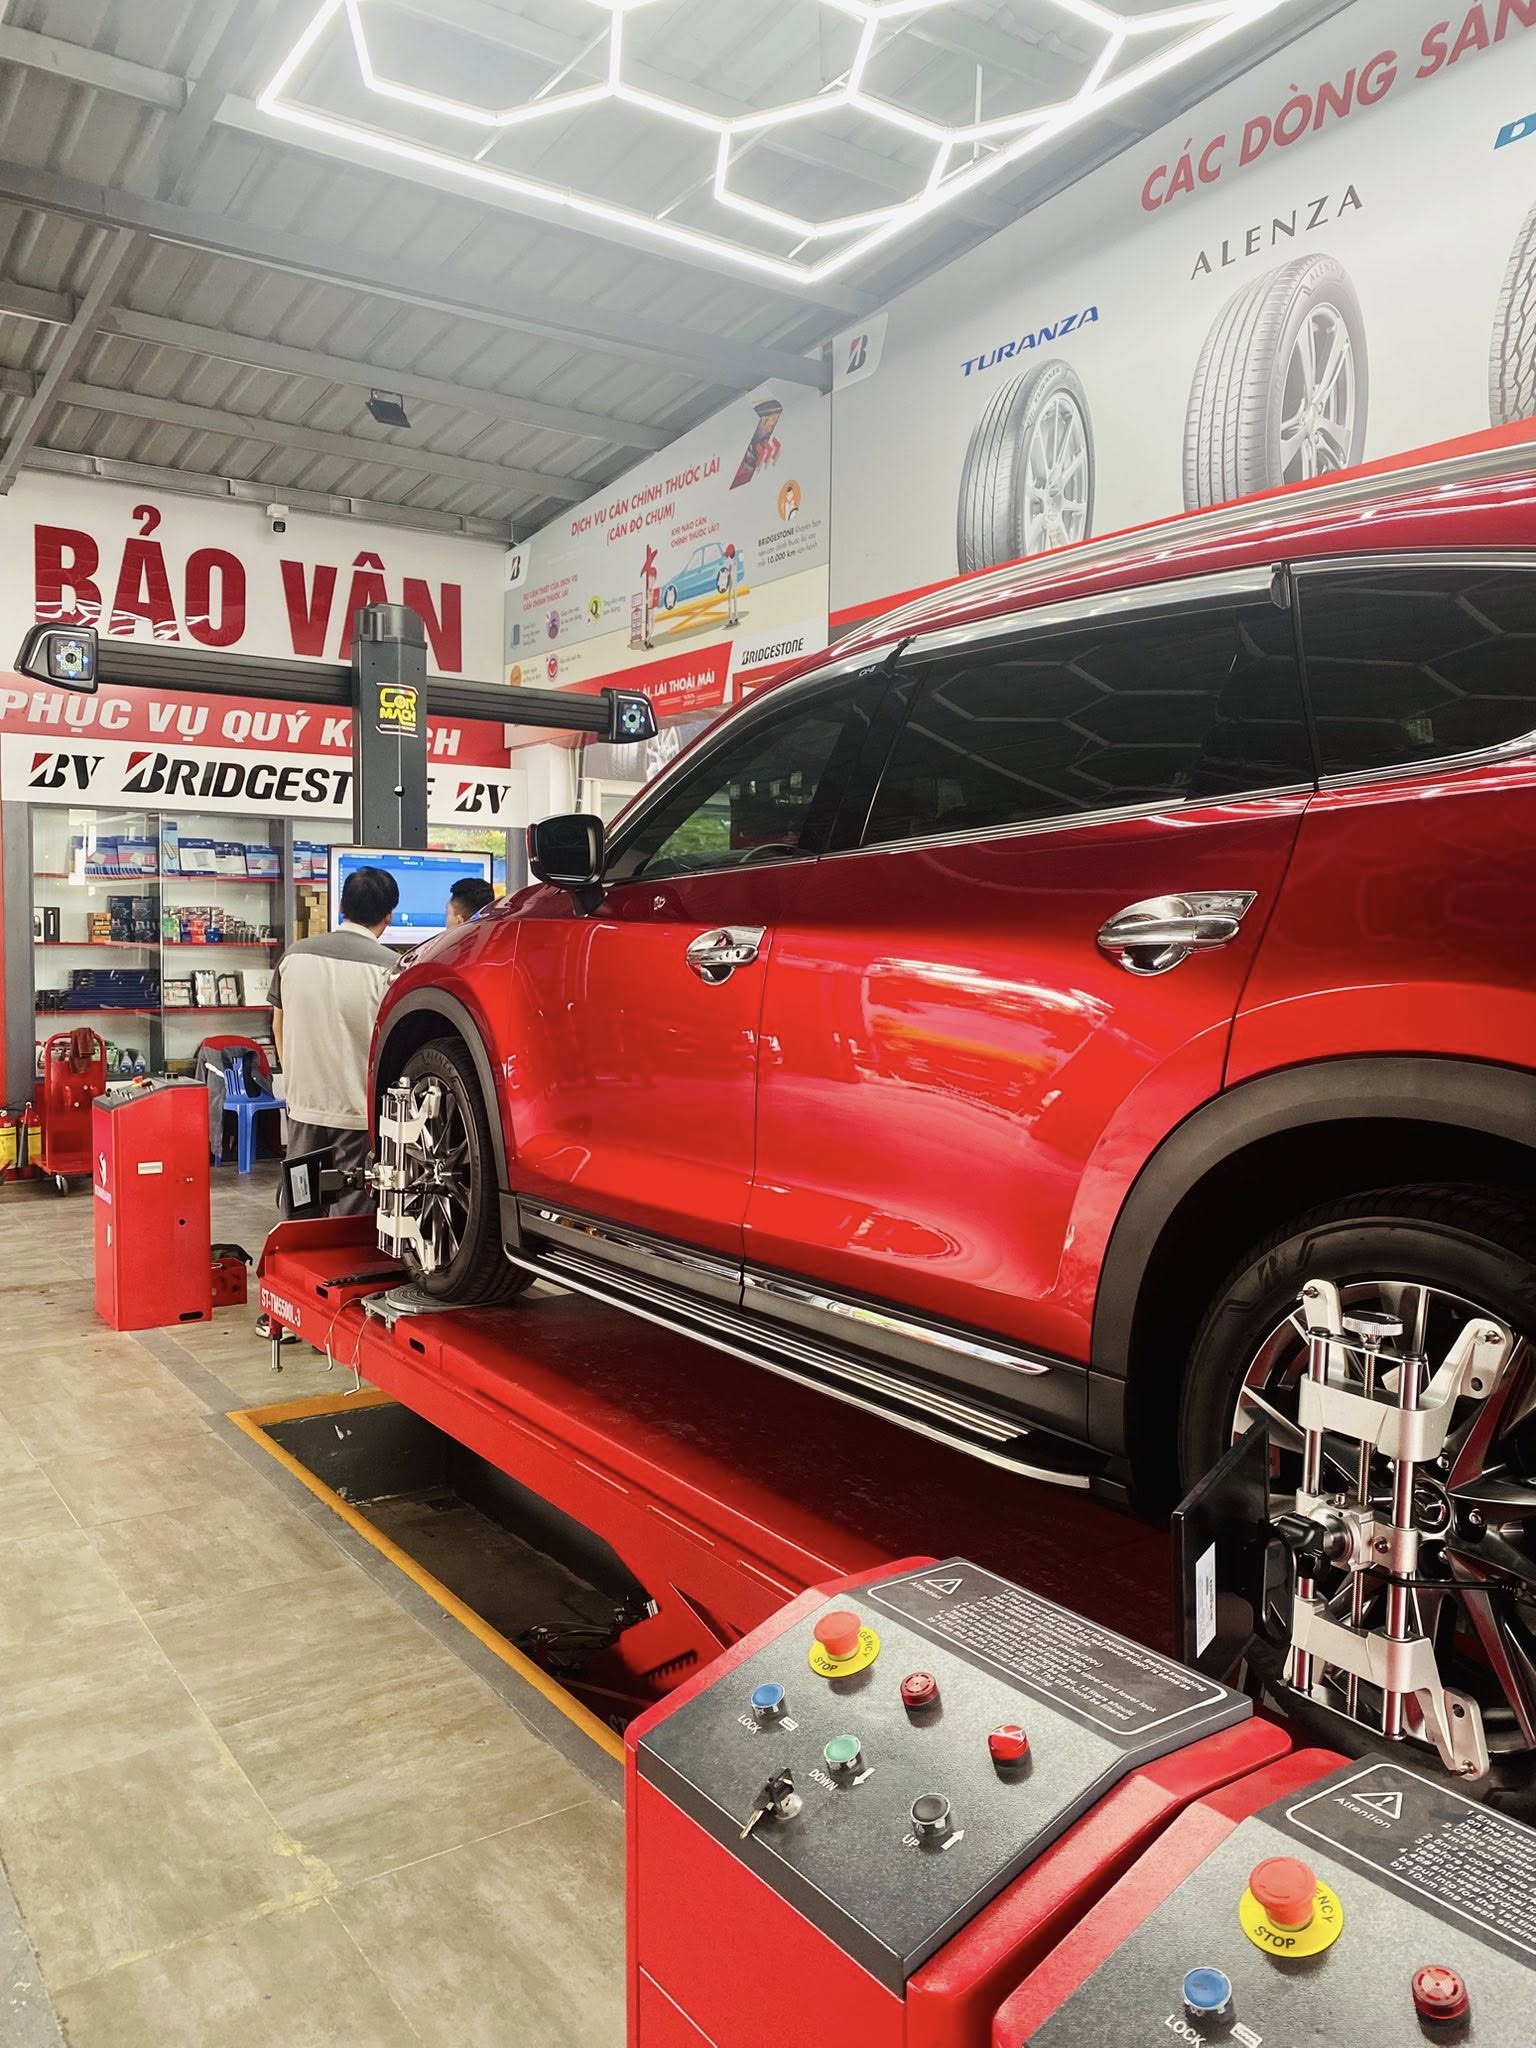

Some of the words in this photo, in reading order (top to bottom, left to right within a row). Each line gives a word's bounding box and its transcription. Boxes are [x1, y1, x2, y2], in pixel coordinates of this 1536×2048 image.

[1141, 138, 1223, 212] CÁC
[1239, 49, 1398, 170] DÒNG
[1189, 184, 1365, 281] ALENZA
[960, 306, 1099, 377] TURANZA
[34, 504, 246, 647] BẢO
[741, 637, 805, 666] BRIDGESTONE
[0, 688, 132, 734] PHỤC
[149, 702, 209, 742] VỤ
[220, 709, 307, 747] QUÝ
[121, 751, 436, 809] BRIDGEST
[859, 1631, 873, 1658] GENCY
[1088, 1638, 1105, 1647] real
[1101, 1645, 1127, 1657] power
[1125, 1656, 1151, 1670] supply
[1158, 1673, 1180, 1685] same
[814, 1656, 838, 1672] STOP
[1143, 1658, 1170, 1673] Before
[1169, 1671, 1207, 1692] switching
[1044, 1652, 1069, 1666] ensure
[1080, 1671, 1104, 1684] upper
[1117, 1690, 1140, 1703] lower
[1138, 1701, 1157, 1713] lock
[1063, 1685, 1092, 1700] should
[1100, 1703, 1130, 1720] filtered
[1088, 1689, 1109, 1702] liters
[1107, 1700, 1137, 1716] should
[737, 1714, 763, 1734] LOCK
[808, 1768, 839, 1792] DOWN
[1332, 1797, 1392, 1829] Attention
[1466, 1819, 1482, 1828] on
[1482, 1826, 1501, 1837] the
[1467, 1810, 1516, 1836] 1.Ensure
[902, 1833, 921, 1847] UP
[1441, 1822, 1486, 1846] 2.Cable
[1458, 1822, 1482, 1836] that
[1481, 1834, 1536, 1862] indicated
[1415, 1838, 1463, 1865] 3.Before
[1463, 1864, 1508, 1889] starting
[1415, 1847, 1444, 1865] teeth
[1445, 1863, 1461, 1874] of
[1458, 1870, 1525, 1907] mechanical
[1431, 1865, 1486, 1894] anti-wear
[1457, 1851, 1495, 1872] 4-core
[1495, 1871, 1528, 1889] cable
[1465, 1844, 1502, 1865] 3-core
[1503, 1864, 1536, 1882] cable
[1390, 1860, 1406, 1871] by
[1438, 1887, 1462, 1901] fine
[1462, 1900, 1495, 1920] mesh
[1398, 1855, 1414, 1866] be
[1412, 1865, 1435, 1877] put
[1434, 1874, 1457, 1889] into
[1457, 1887, 1476, 1898] for
[1475, 1897, 1496, 1910] the
[1498, 1909, 1518, 1921] 1st
[1253, 1925, 1296, 1949] STOP
[1164, 2013, 1207, 2048] LOCK
